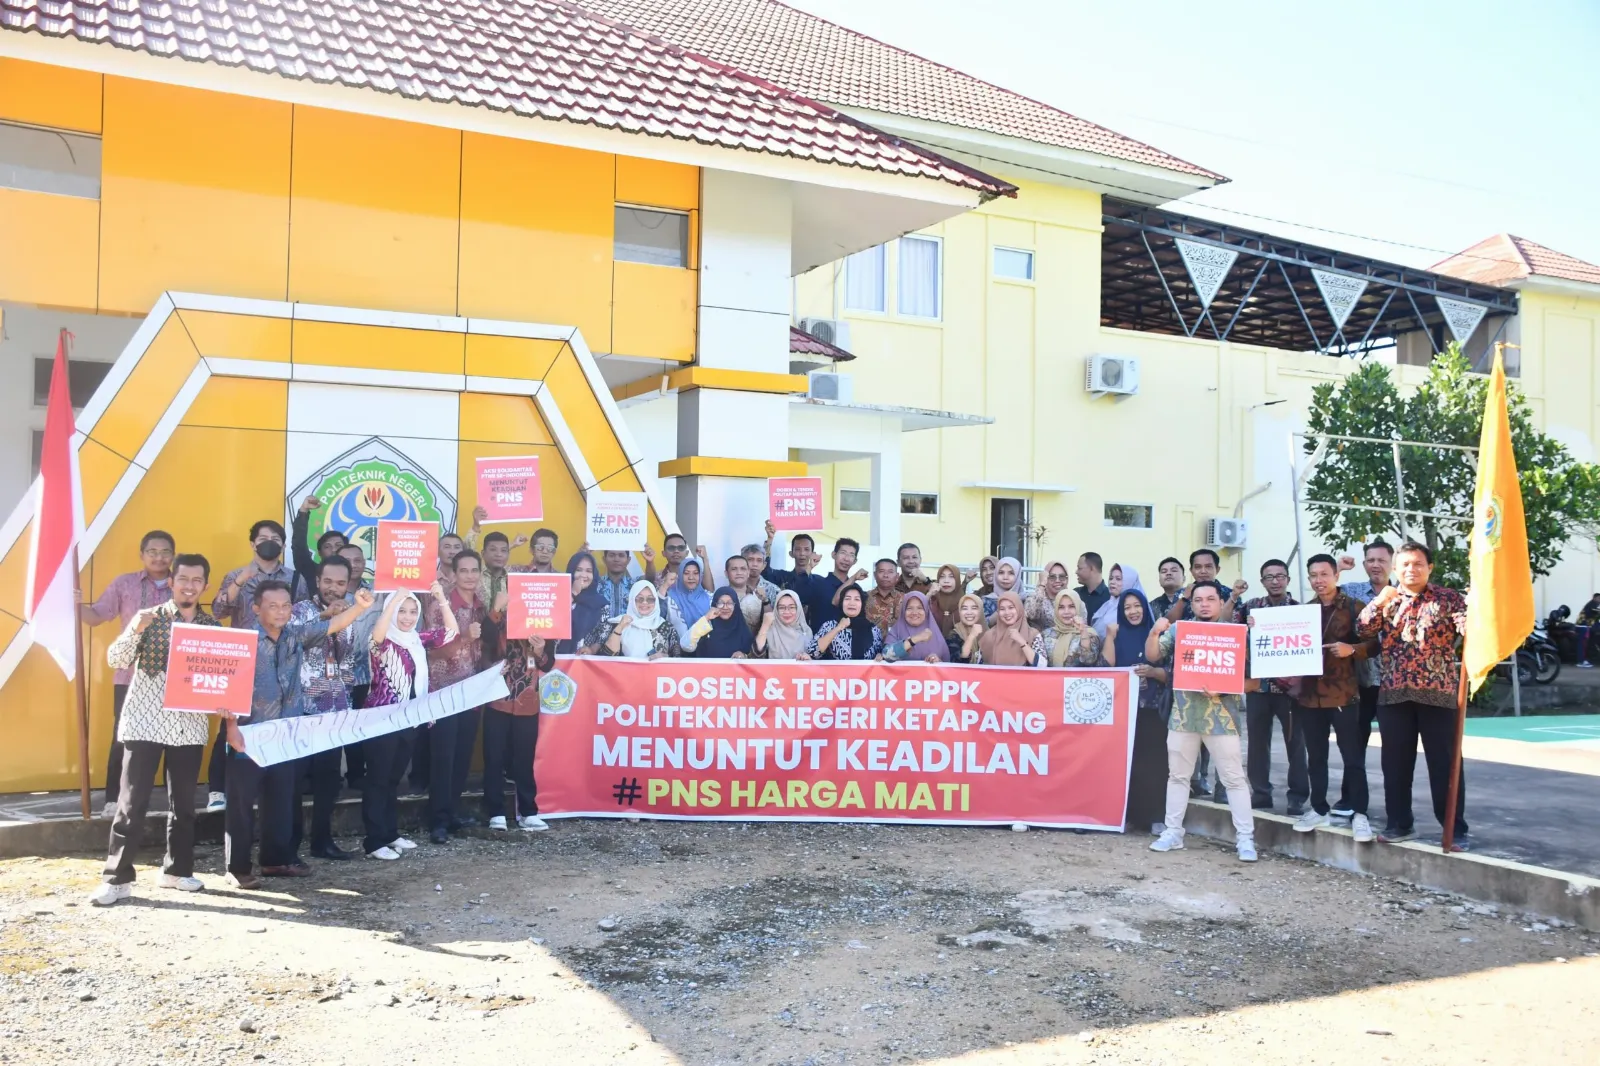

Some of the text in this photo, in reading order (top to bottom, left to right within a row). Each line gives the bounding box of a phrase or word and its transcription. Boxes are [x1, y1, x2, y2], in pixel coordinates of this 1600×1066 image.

[320, 470, 428, 508] POLITEKNIK NEGERI
[775, 498, 815, 510] #PNS
[592, 513, 640, 527] #PNS
[394, 567, 420, 579] PNS
[526, 618, 553, 628] PNS
[200, 640, 248, 651] SOLIDARITAS
[1256, 634, 1312, 649] #PNS
[198, 648, 251, 658] SE-INDONESIA
[1182, 649, 1236, 667] #PNS
[186, 656, 240, 666] MENUNTUT
[188, 665, 236, 675] KEADILAN
[1181, 665, 1236, 675] HARGA MATI
[184, 674, 228, 689] #PNS
[656, 677, 980, 704] DOSEN & TENDIK PPPK
[597, 703, 1046, 734] POLITEKNIK NEGERI KETAPANG
[593, 734, 1048, 776] MENUNTUT KEADILAN
[731, 780, 866, 809] HARGA
[875, 781, 969, 812] MATI
